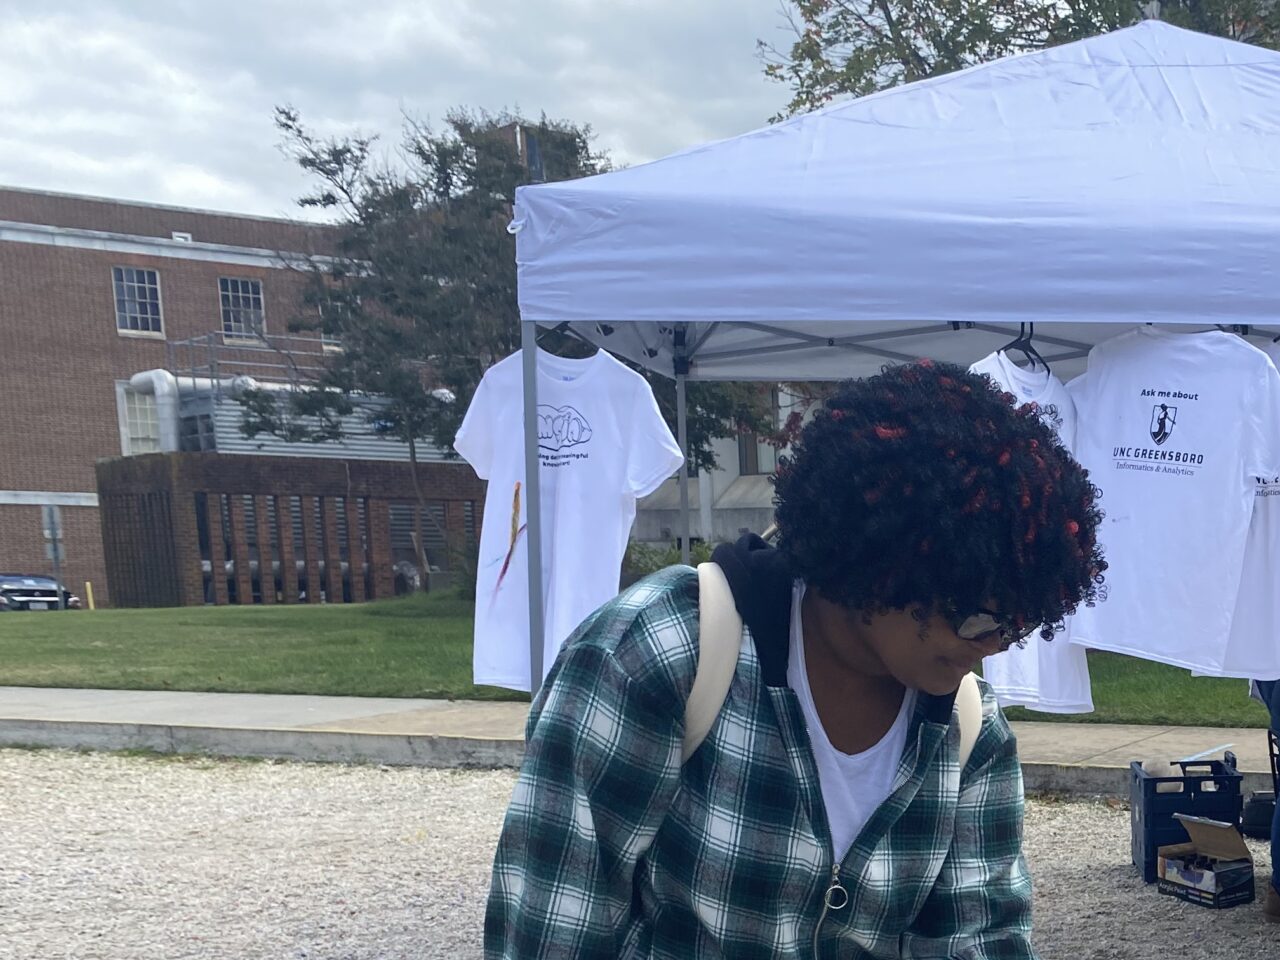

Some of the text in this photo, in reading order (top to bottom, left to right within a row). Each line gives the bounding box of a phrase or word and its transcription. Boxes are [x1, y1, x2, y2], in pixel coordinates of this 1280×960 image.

[1140, 388, 1199, 401] Ask me about
[1113, 447, 1203, 464] UNC GREENSBORO
[1116, 462, 1154, 472] Informatics
[1162, 466, 1194, 476] Analytics
